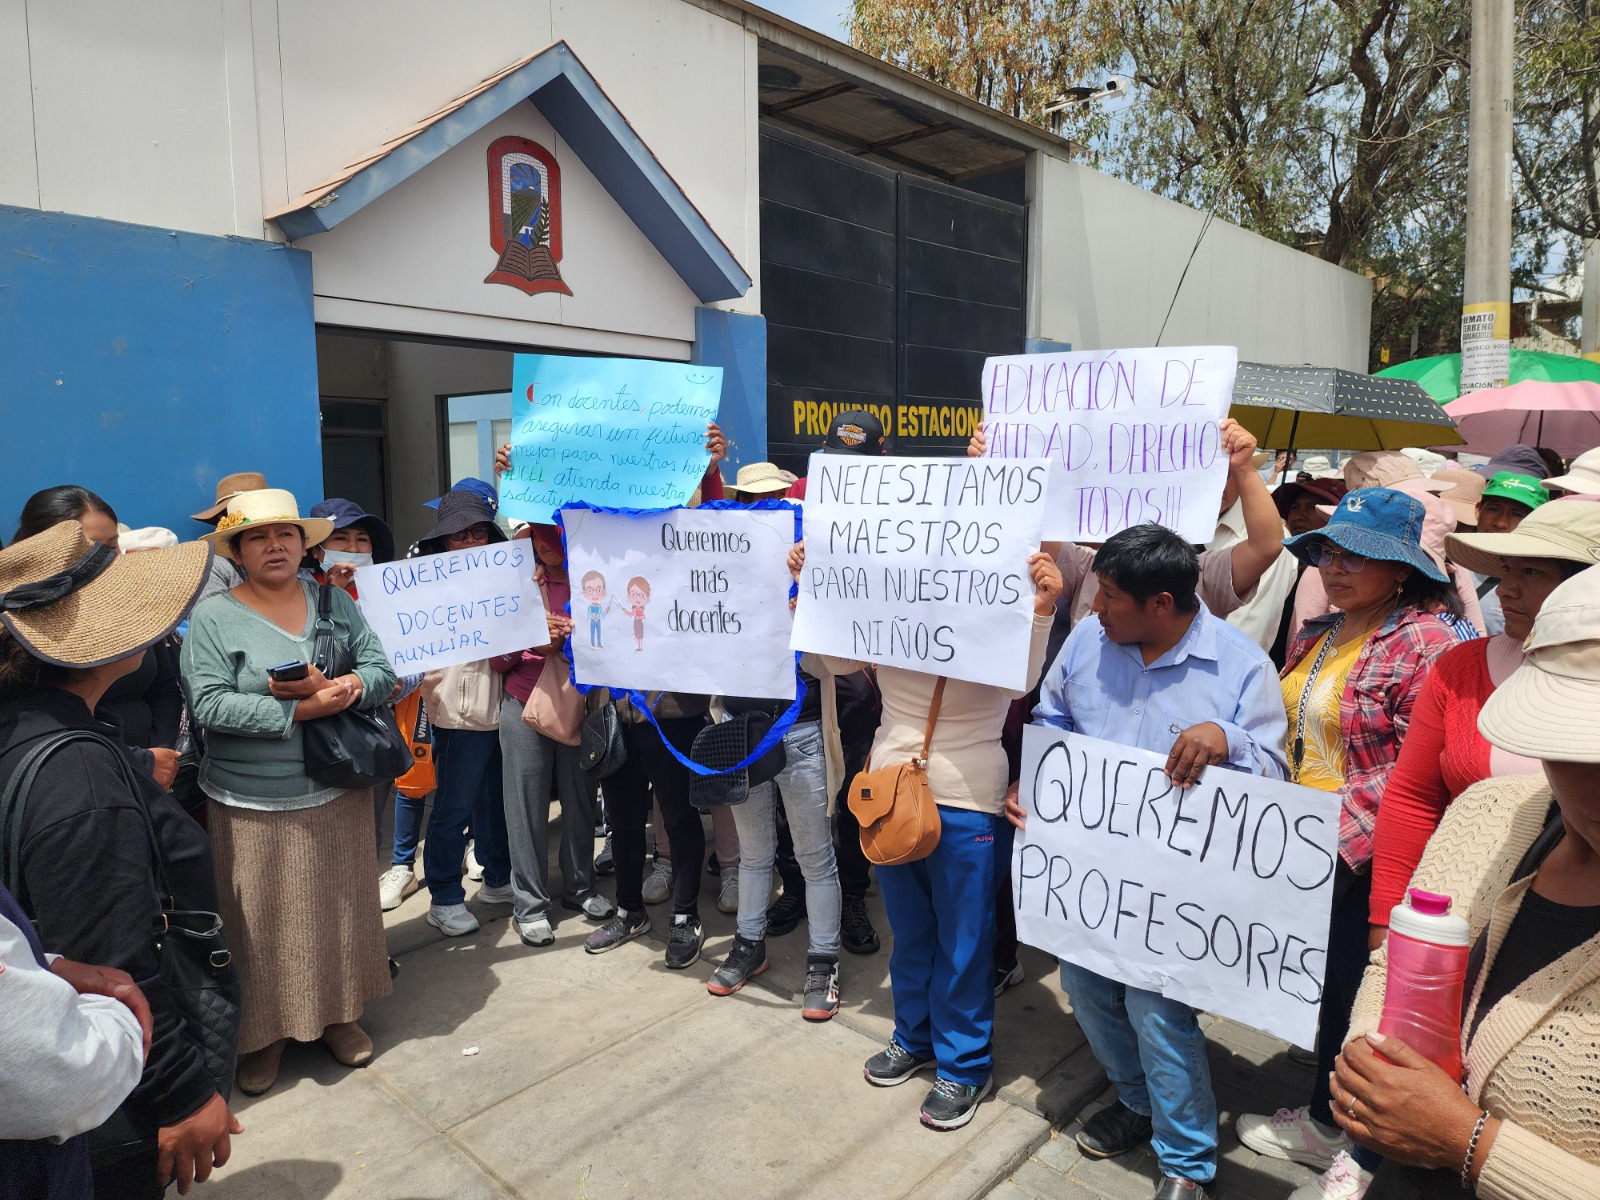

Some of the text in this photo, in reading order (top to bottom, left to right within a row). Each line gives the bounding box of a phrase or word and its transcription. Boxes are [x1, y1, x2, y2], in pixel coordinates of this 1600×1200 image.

[526, 382, 562, 406] Con
[989, 350, 1206, 415] EDUCACIÓN DE
[521, 419, 705, 448] asegurar un futuro
[898, 405, 984, 438] ESTACION
[514, 445, 556, 464] mejor
[561, 447, 602, 464] para
[611, 452, 676, 472] nuestros
[983, 420, 1218, 474] ALIDAD, DERECHO
[553, 466, 620, 494] atienda
[628, 481, 685, 500] nuestra
[820, 463, 1045, 506] NECESITAMOS
[661, 522, 751, 554] Queremos
[830, 518, 1003, 556] MAESTROS
[382, 547, 524, 595] QUEREMOS
[690, 565, 729, 593] más
[811, 566, 1021, 605] PARA NUESTROS
[396, 595, 520, 636] DOCENTES
[668, 599, 742, 635] docentes
[394, 630, 489, 666] AUXILIAR
[852, 615, 955, 663] NIÑOS
[1033, 740, 1334, 890] QUEREMOS
[1018, 844, 1326, 1005] PROFESORES
